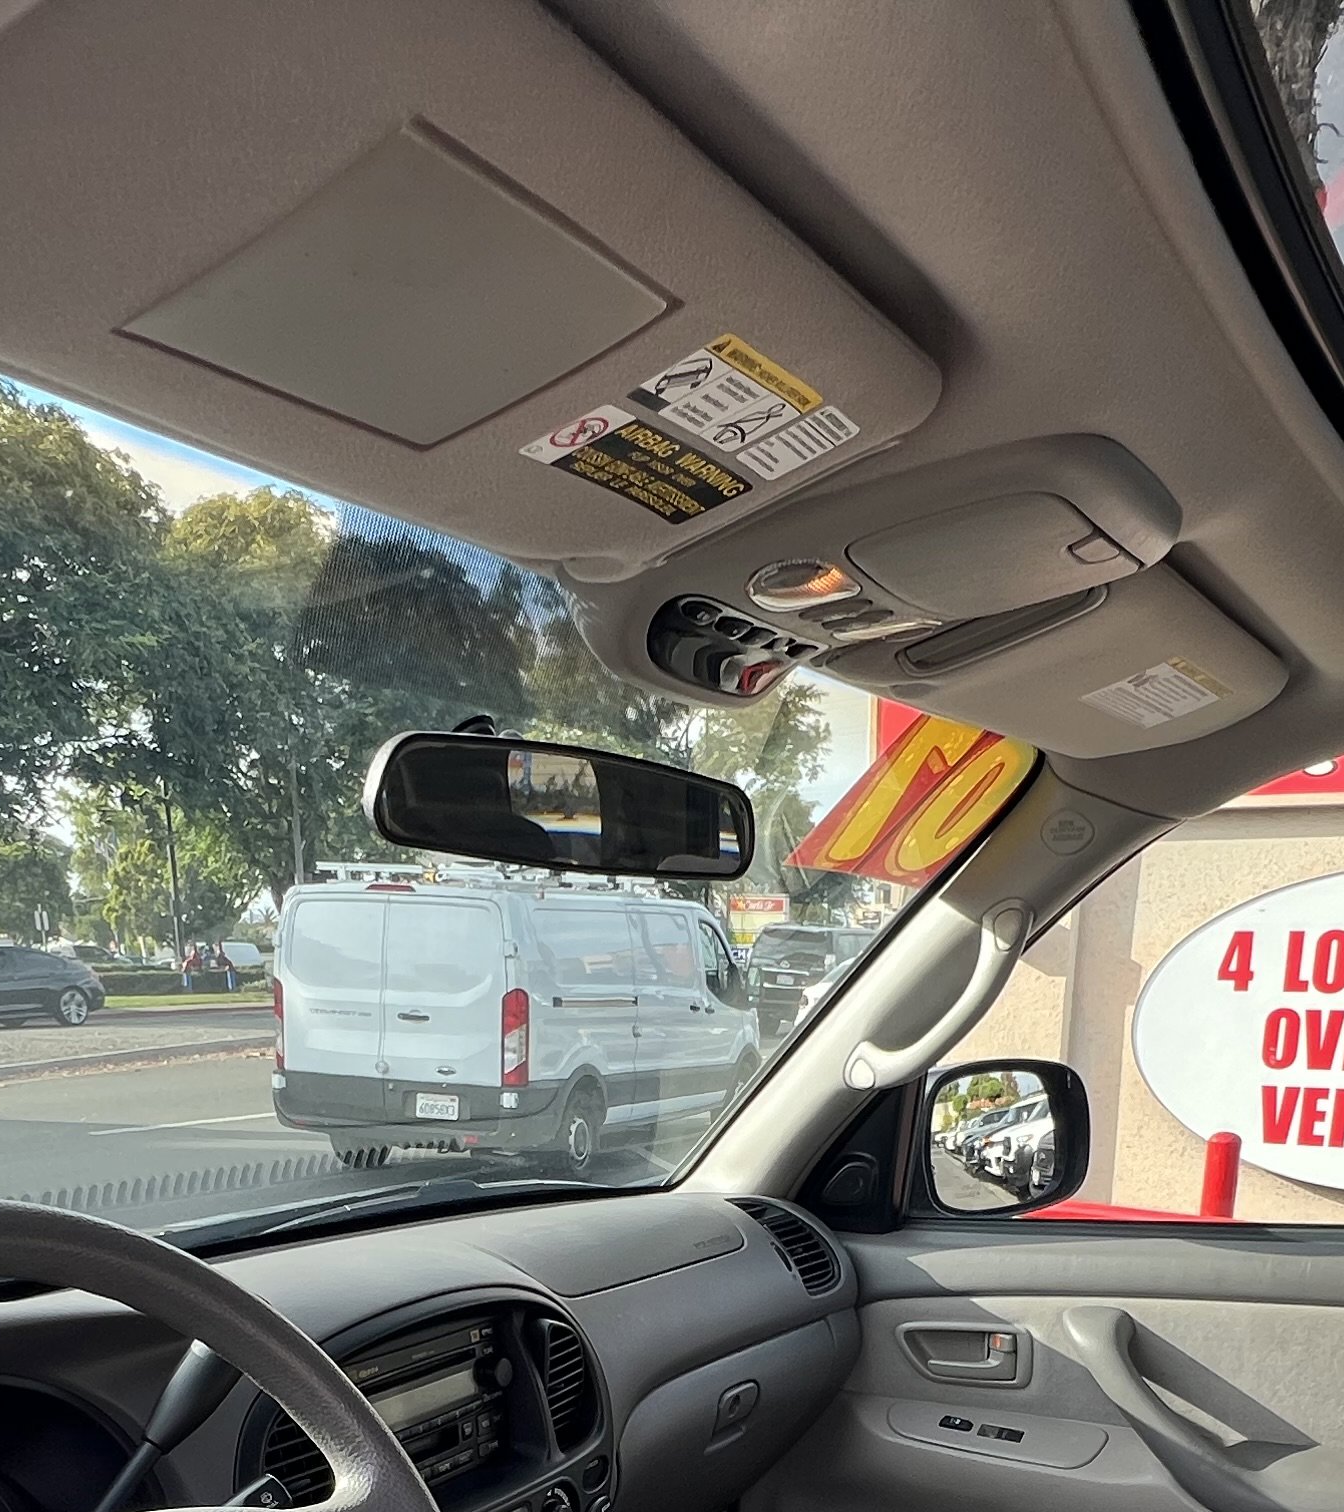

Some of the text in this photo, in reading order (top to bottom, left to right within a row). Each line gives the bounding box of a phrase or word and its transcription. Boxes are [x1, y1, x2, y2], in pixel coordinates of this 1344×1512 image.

[615, 424, 680, 458] AIRBAG
[675, 452, 745, 498] WARNING
[1217, 931, 1254, 992] 4
